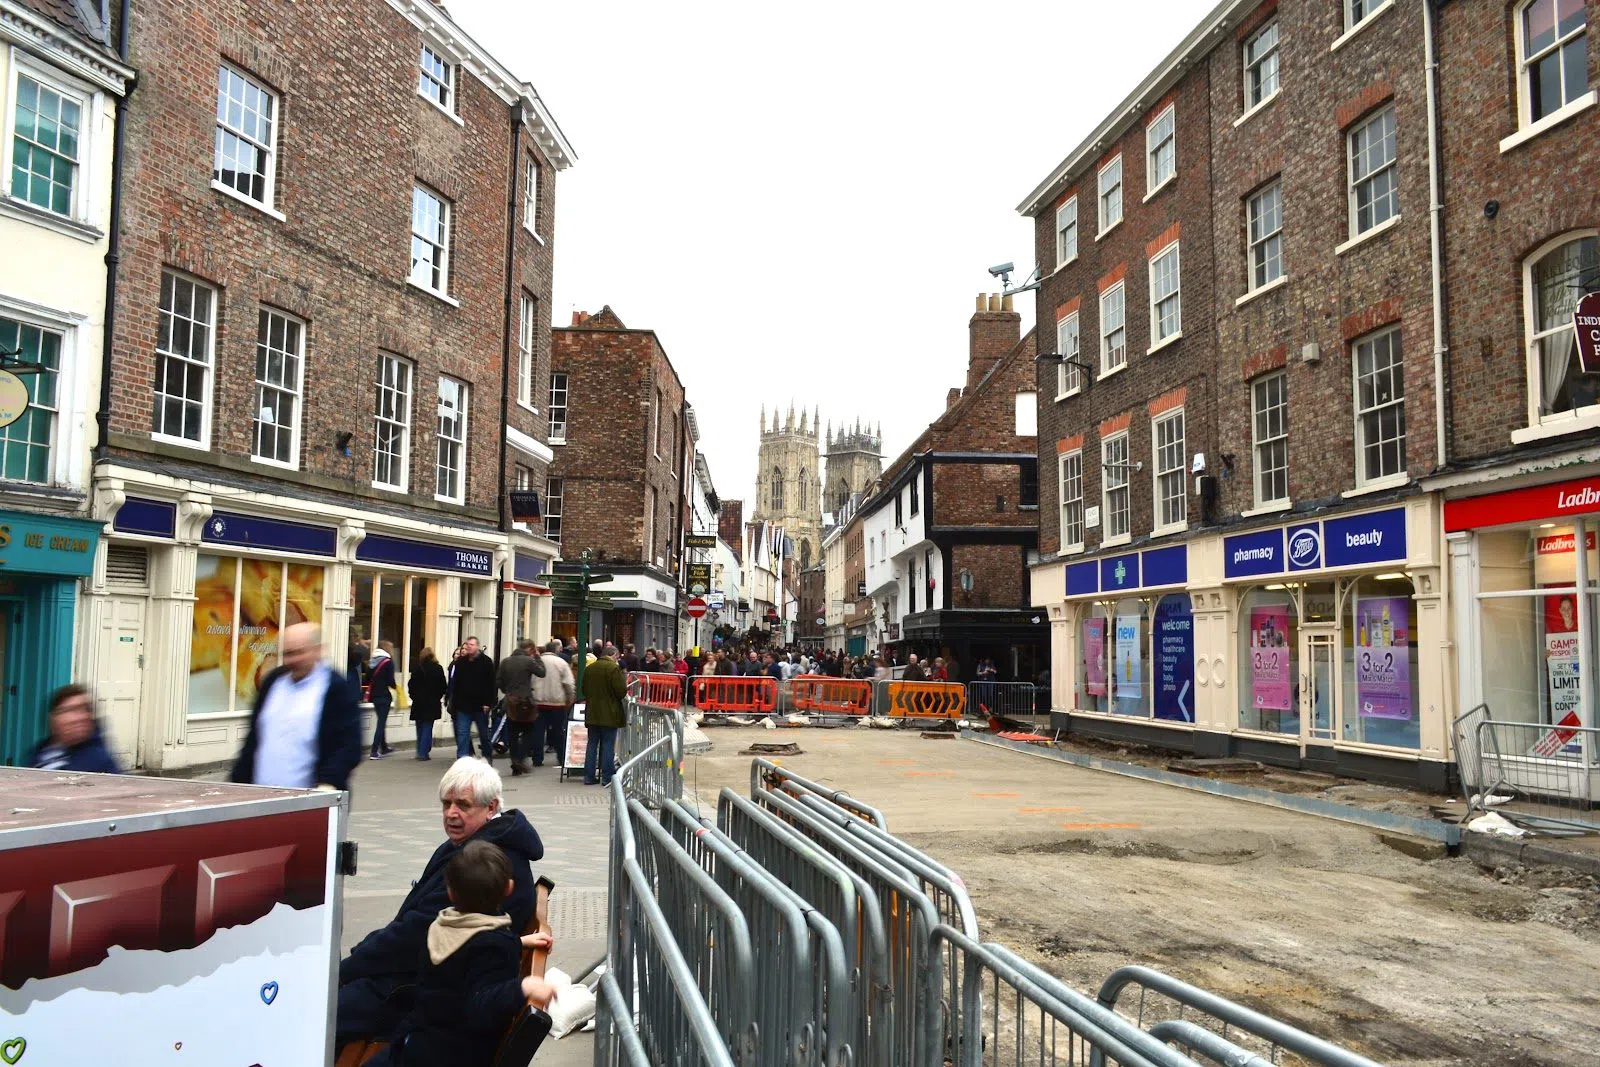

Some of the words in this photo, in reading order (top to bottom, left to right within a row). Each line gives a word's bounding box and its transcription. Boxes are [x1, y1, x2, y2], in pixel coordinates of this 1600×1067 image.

[25, 531, 44, 549] ICE
[50, 534, 89, 553] CREAM
[1345, 528, 1383, 547] beauty
[1293, 537, 1314, 559] Boots
[455, 551, 488, 565] THOMAS
[1234, 546, 1274, 565] pharmacy
[461, 561, 489, 571] BAKER
[1162, 619, 1191, 631] welcome
[1118, 626, 1136, 640] new
[1162, 636, 1184, 646] pharmacy
[1163, 645, 1186, 653] healthcare
[1163, 654, 1178, 664] beauty
[1255, 652, 1262, 670] 3
[1263, 660, 1272, 670] for
[1271, 652, 1279, 670] 2
[1362, 652, 1371, 672] 3
[1373, 662, 1384, 673] for
[1384, 652, 1394, 673] 2
[1163, 663, 1174, 672] food
[1163, 672, 1174, 683] baby
[1163, 683, 1177, 691] photo
